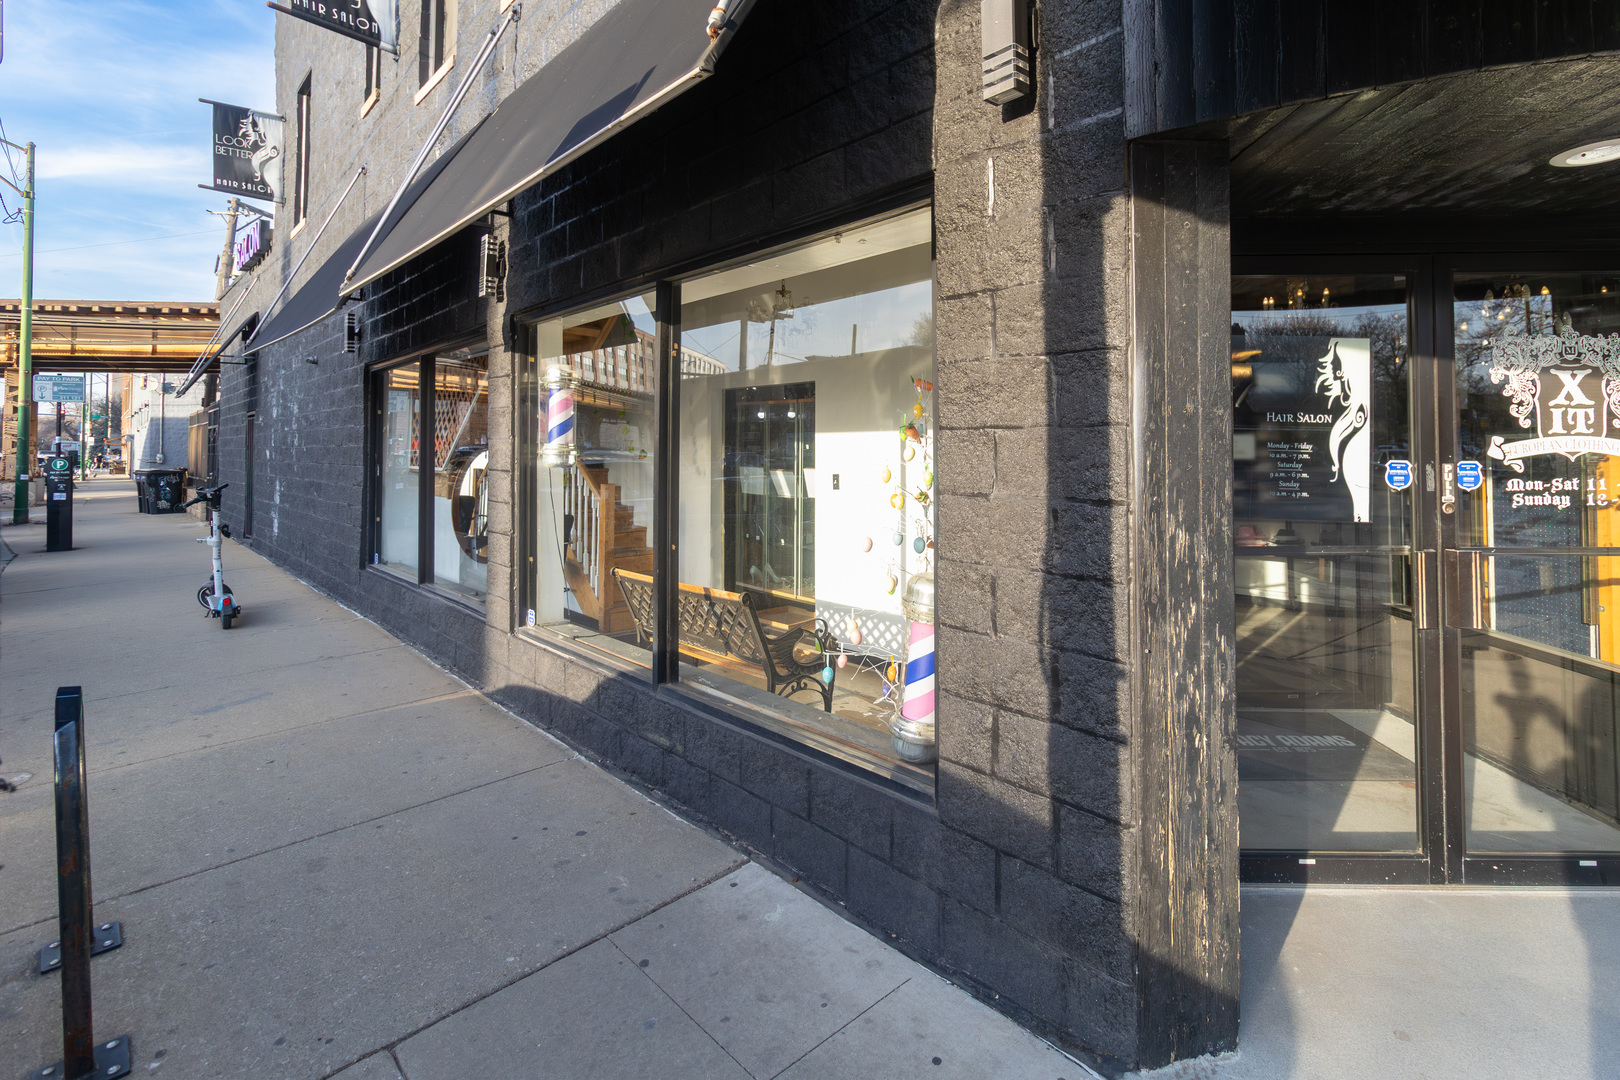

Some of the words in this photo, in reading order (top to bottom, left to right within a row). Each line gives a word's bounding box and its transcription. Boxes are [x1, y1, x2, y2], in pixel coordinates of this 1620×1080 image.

[332, 8, 378, 34] SALON
[215, 133, 251, 149] LOOK
[215, 145, 253, 159] BETTER
[216, 178, 238, 188] HAIR
[241, 181, 273, 194] SALON
[235, 220, 260, 271] SALON
[1548, 368, 1595, 407] X
[1548, 407, 1595, 435] IT
[1267, 442, 1290, 451] Monday
[1294, 442, 1313, 452] Friday
[1508, 440, 1562, 456] EUROPEAN
[1565, 438, 1620, 453] CLOTHING
[1277, 461, 1303, 470] Saturday
[1278, 481, 1300, 490] Sunday
[1444, 464, 1453, 497] PULL
[1505, 477, 1580, 493] Mon-Sat
[1586, 478, 1607, 491] 11
[1511, 491, 1571, 510] Sunday
[1238, 735, 1275, 747] ACY
[1275, 735, 1356, 747] ADAMS
